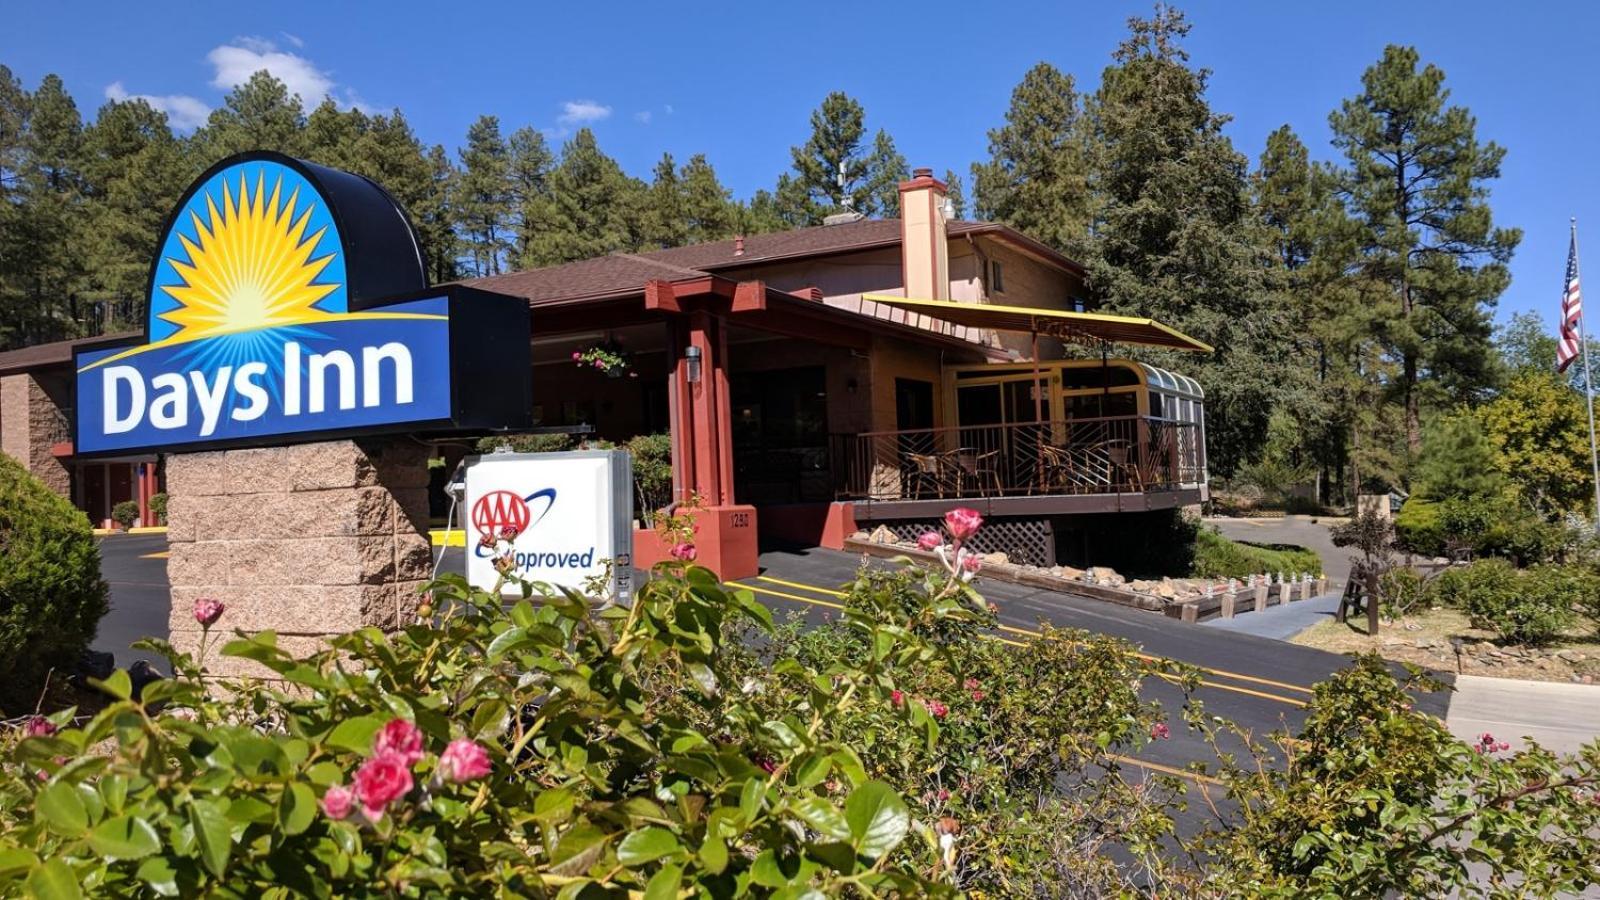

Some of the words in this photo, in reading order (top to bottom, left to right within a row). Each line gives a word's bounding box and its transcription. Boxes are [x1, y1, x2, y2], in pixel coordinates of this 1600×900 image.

[103, 362, 269, 436] Days
[284, 341, 414, 416] Inn
[474, 490, 529, 536] AAA
[499, 547, 595, 572] pproved
